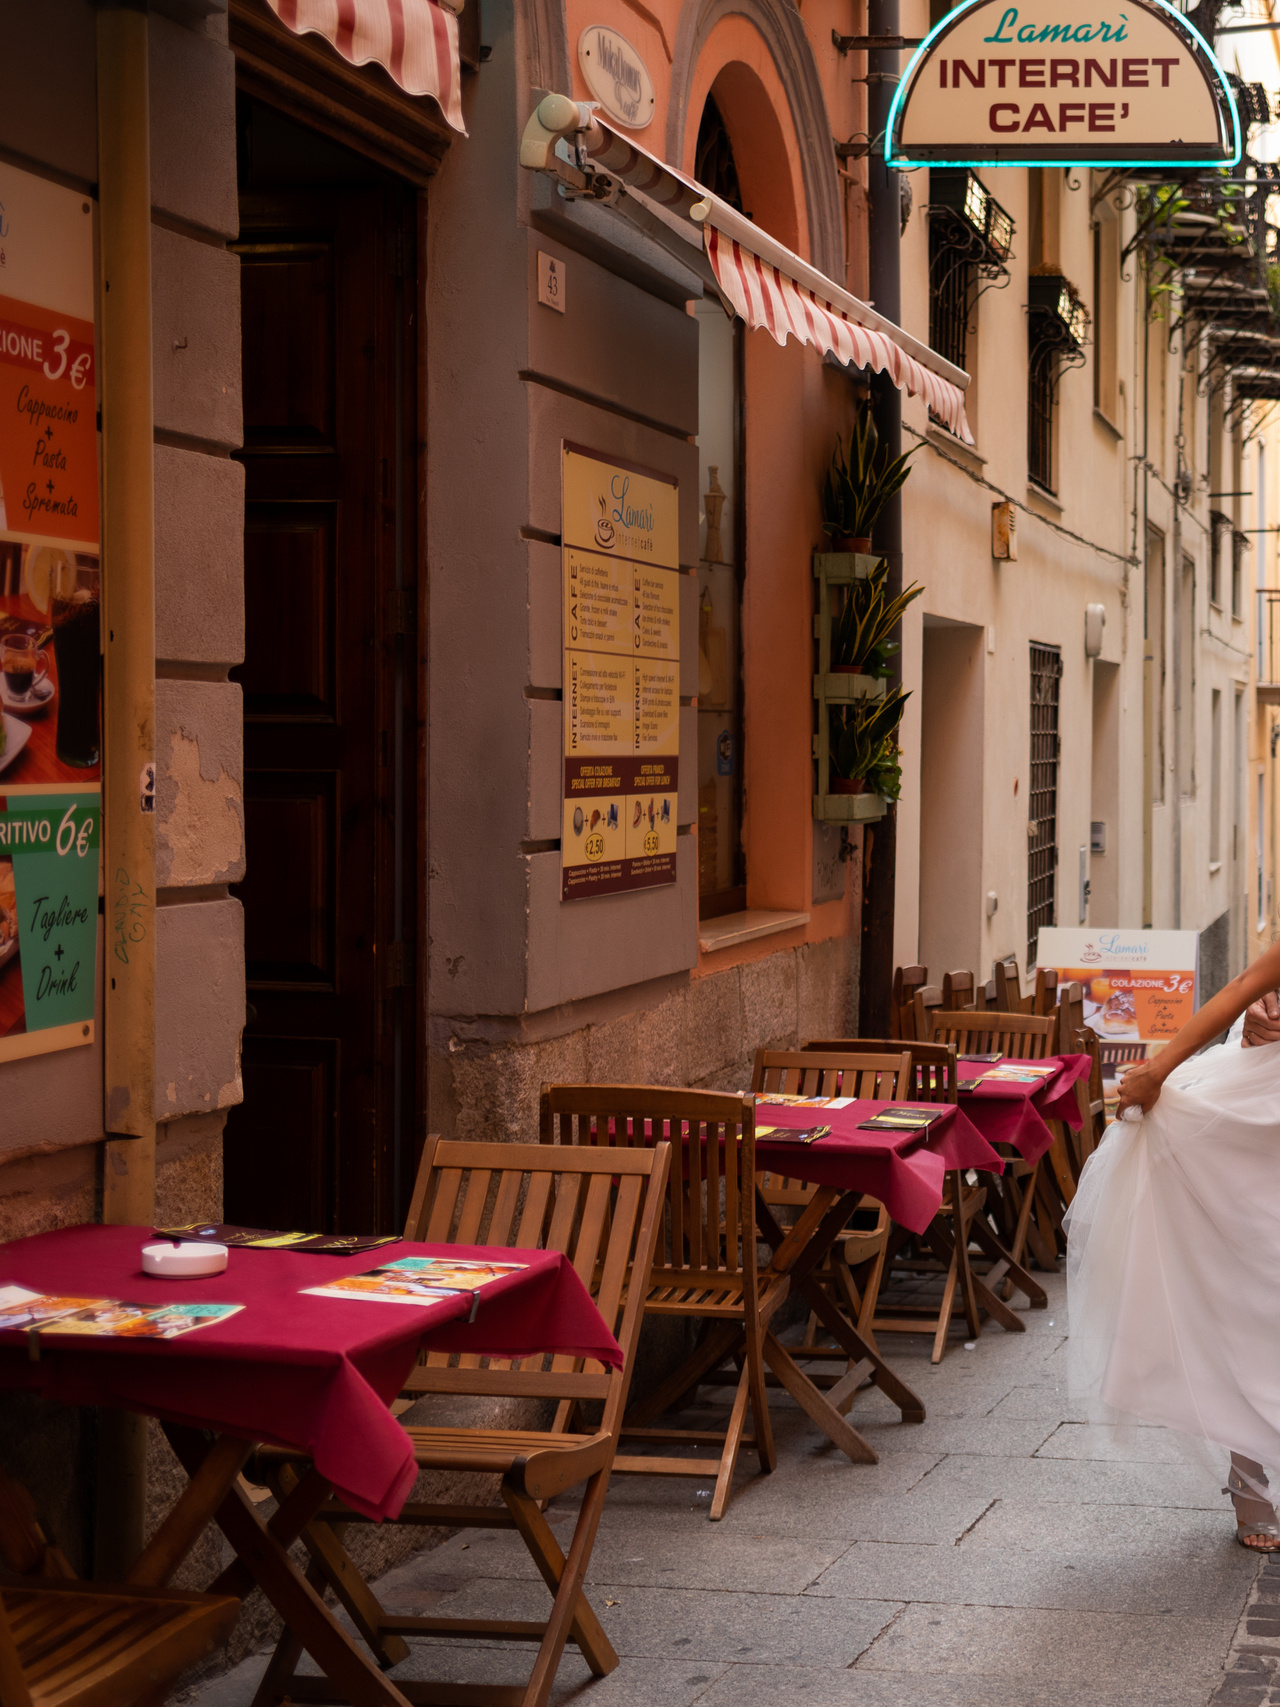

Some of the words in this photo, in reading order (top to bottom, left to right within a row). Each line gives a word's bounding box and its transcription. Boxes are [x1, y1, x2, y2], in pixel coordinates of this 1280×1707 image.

[983, 8, 1128, 44] Lamarì
[939, 58, 1180, 88] INTERNET
[988, 103, 1129, 133] CAFE'
[548, 274, 557, 296] 43
[0, 330, 43, 362] IONE
[17, 384, 78, 426] Cappuccino
[33, 439, 66, 471] Pasta
[23, 482, 78, 521] Spremuta
[611, 475, 654, 532] Lamarì
[31, 896, 88, 941] Tagliere
[37, 961, 79, 1000] Drink
[1111, 979, 1164, 988] COLAZIONE
